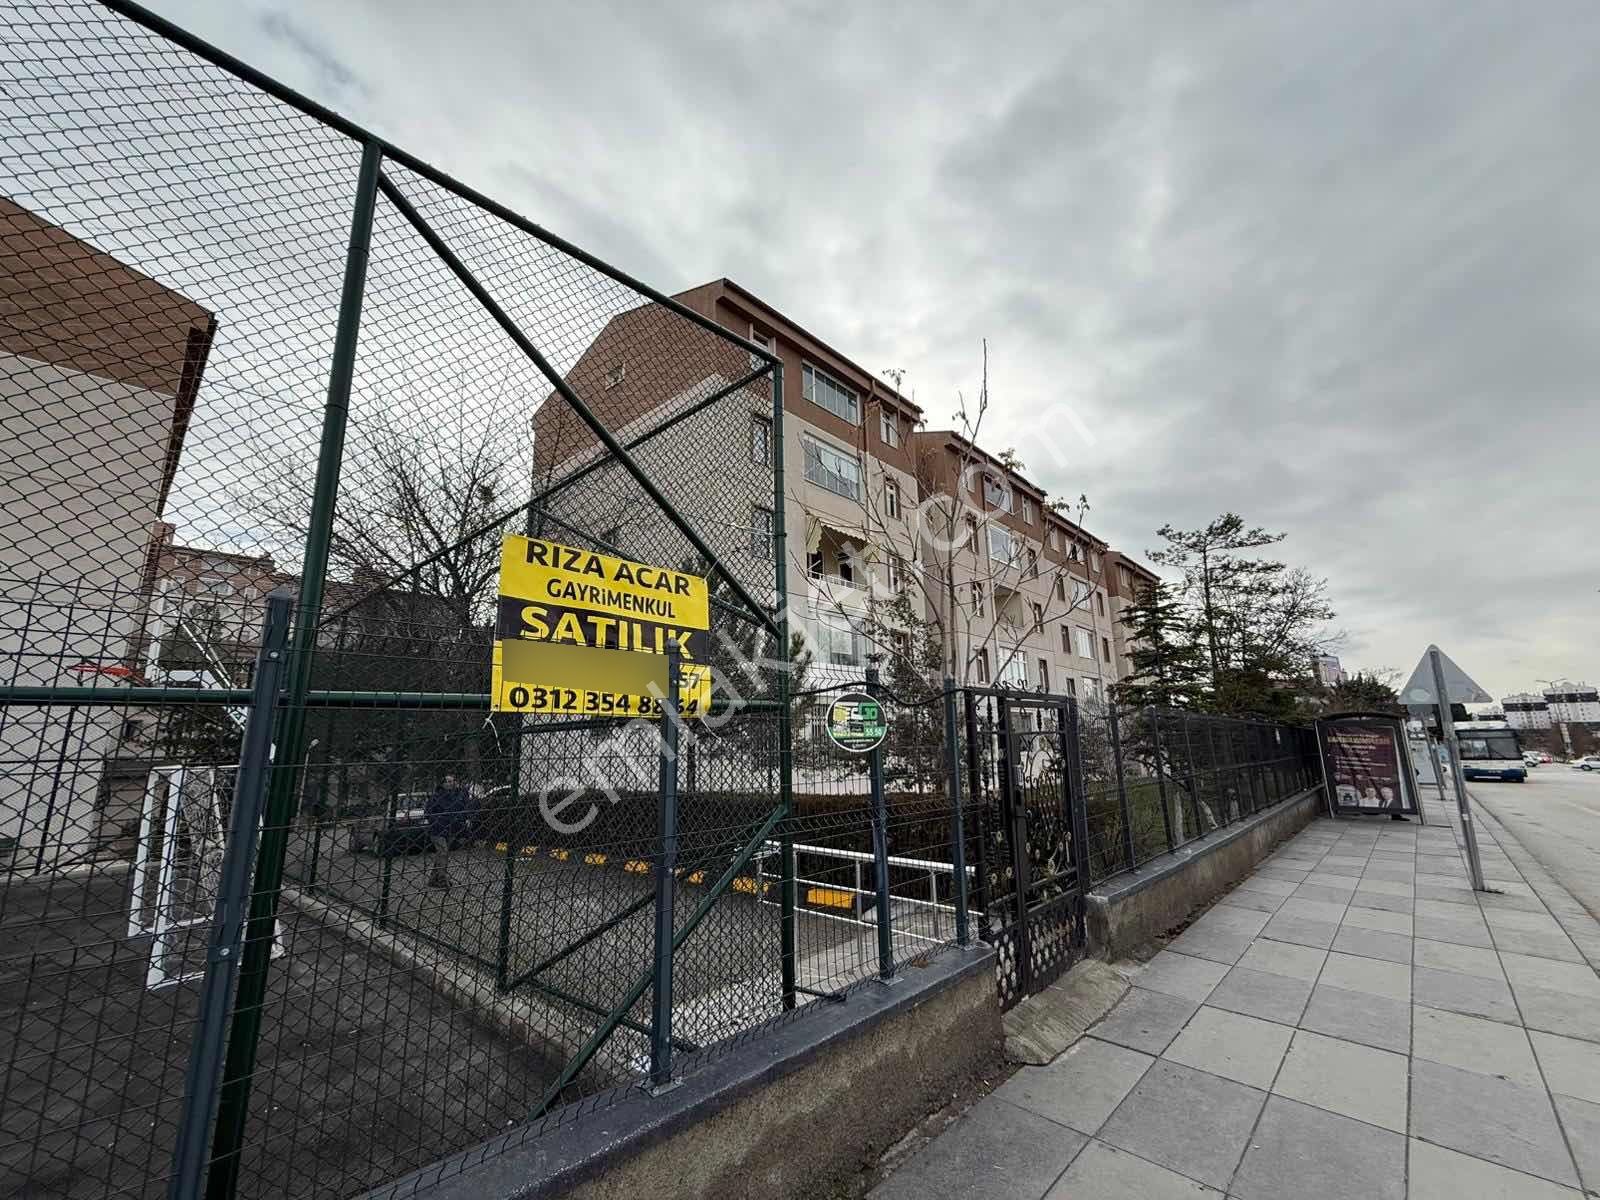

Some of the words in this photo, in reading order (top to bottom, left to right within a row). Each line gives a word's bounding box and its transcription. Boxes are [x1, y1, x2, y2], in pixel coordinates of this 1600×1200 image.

[525, 540, 605, 579] RIZA
[613, 563, 690, 597] ACAR
[520, 606, 694, 660] SATILIK
[509, 686, 578, 711] 0312
[585, 691, 630, 713] 354
